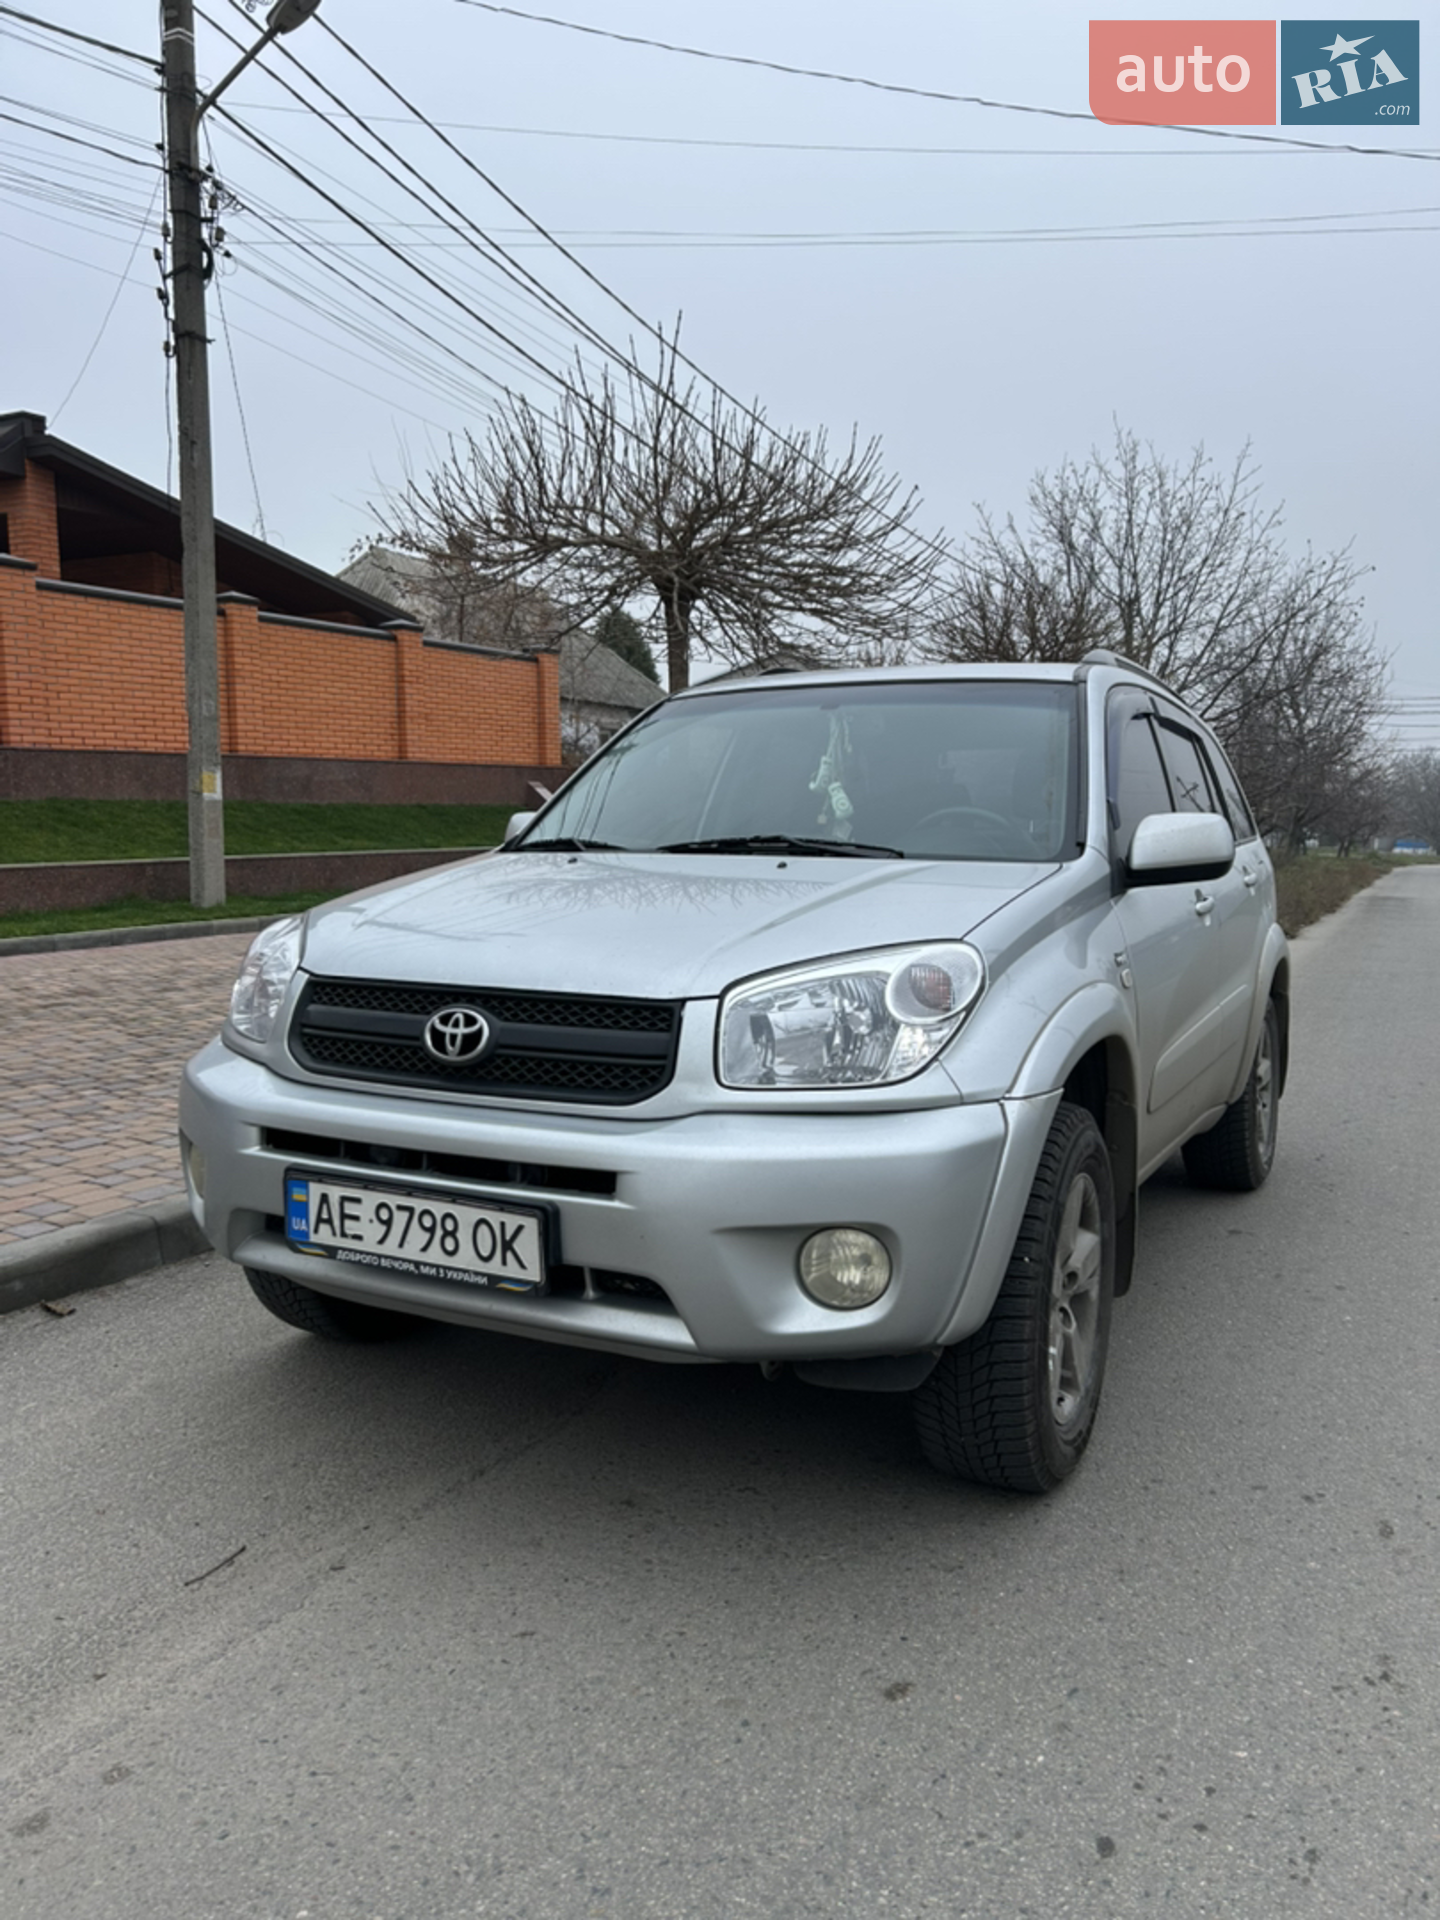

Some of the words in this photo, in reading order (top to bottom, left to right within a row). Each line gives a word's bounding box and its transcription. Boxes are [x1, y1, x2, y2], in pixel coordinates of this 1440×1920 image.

[291, 1217, 308, 1231] UA
[313, 1192, 364, 1241] AE
[374, 1201, 460, 1257] 9798
[472, 1217, 528, 1270] OK
[336, 1249, 380, 1266] ДОБРОГО
